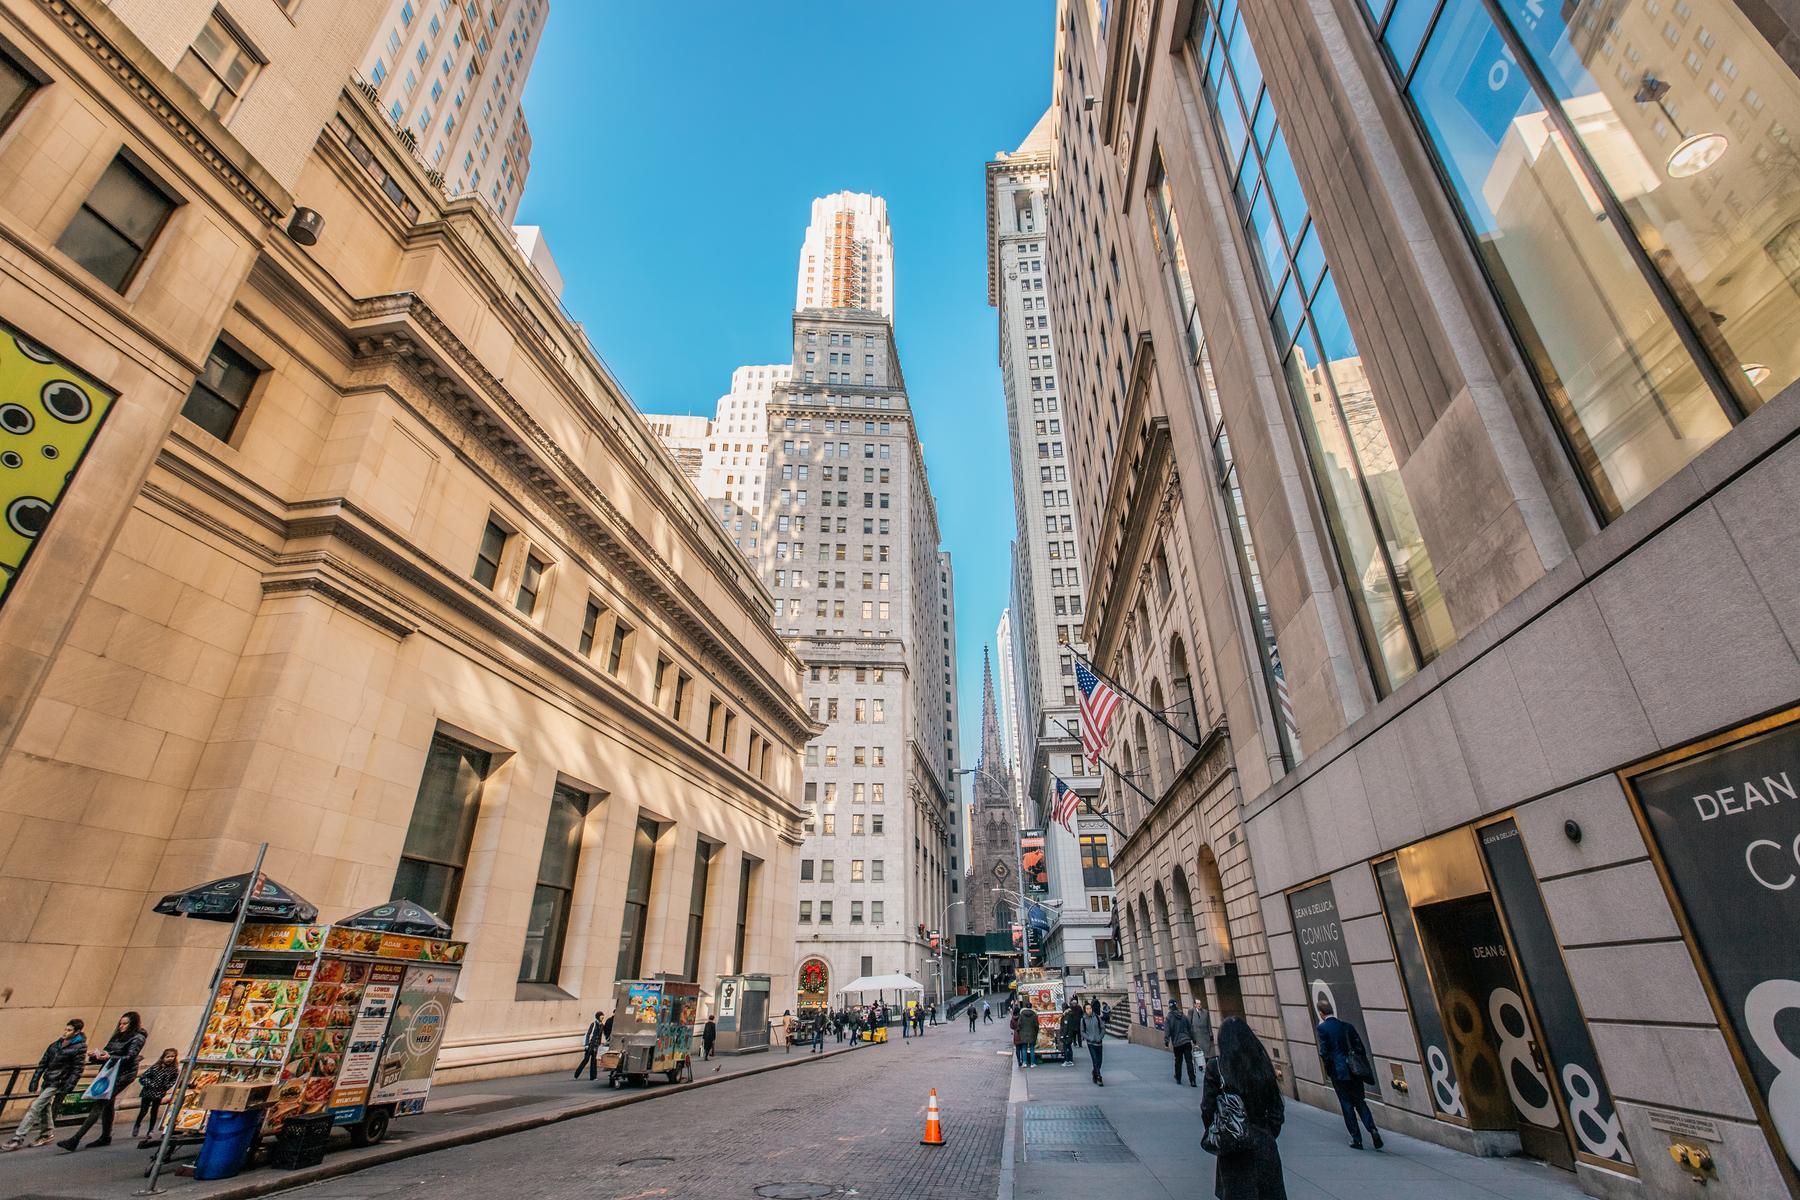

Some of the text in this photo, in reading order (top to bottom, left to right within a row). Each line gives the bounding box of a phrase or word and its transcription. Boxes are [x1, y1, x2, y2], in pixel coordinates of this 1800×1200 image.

[1692, 772, 1798, 821] DEAN
[1294, 907, 1308, 918] DEAN
[1312, 900, 1333, 914] DELUCA
[1301, 922, 1339, 945] COMING
[1473, 946, 1499, 959] DEAN
[1310, 950, 1340, 969] SOON
[417, 1015, 440, 1024] YOUR
[421, 1025, 433, 1035] AD
[416, 1035, 432, 1043] HERE
[384, 1072, 400, 1085] BOX
